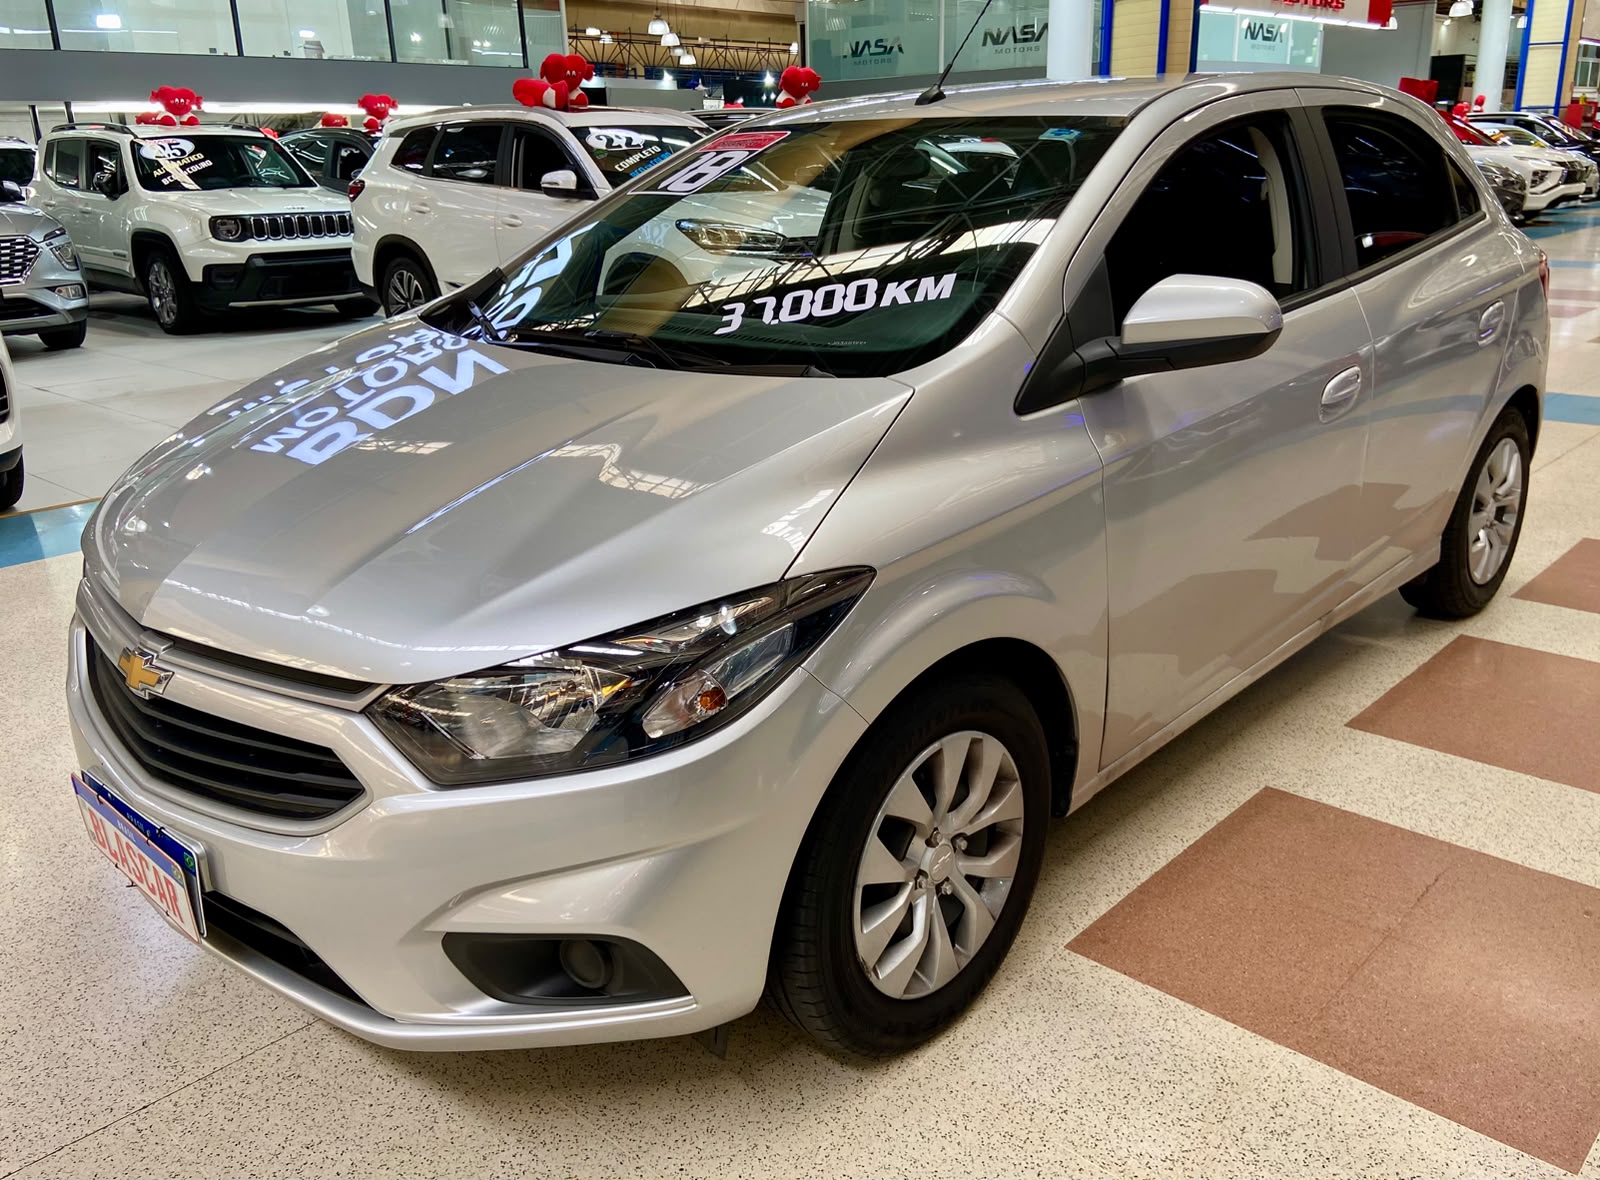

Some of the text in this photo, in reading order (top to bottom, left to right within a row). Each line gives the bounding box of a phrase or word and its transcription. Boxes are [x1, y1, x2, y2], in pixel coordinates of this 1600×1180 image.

[1244, 21, 1283, 43] NASA
[843, 37, 905, 59] NASA
[994, 45, 1041, 55] MOTORS
[614, 145, 662, 172] COMPLETO
[657, 150, 750, 192] 18
[88, 808, 185, 924] BLASCAR
